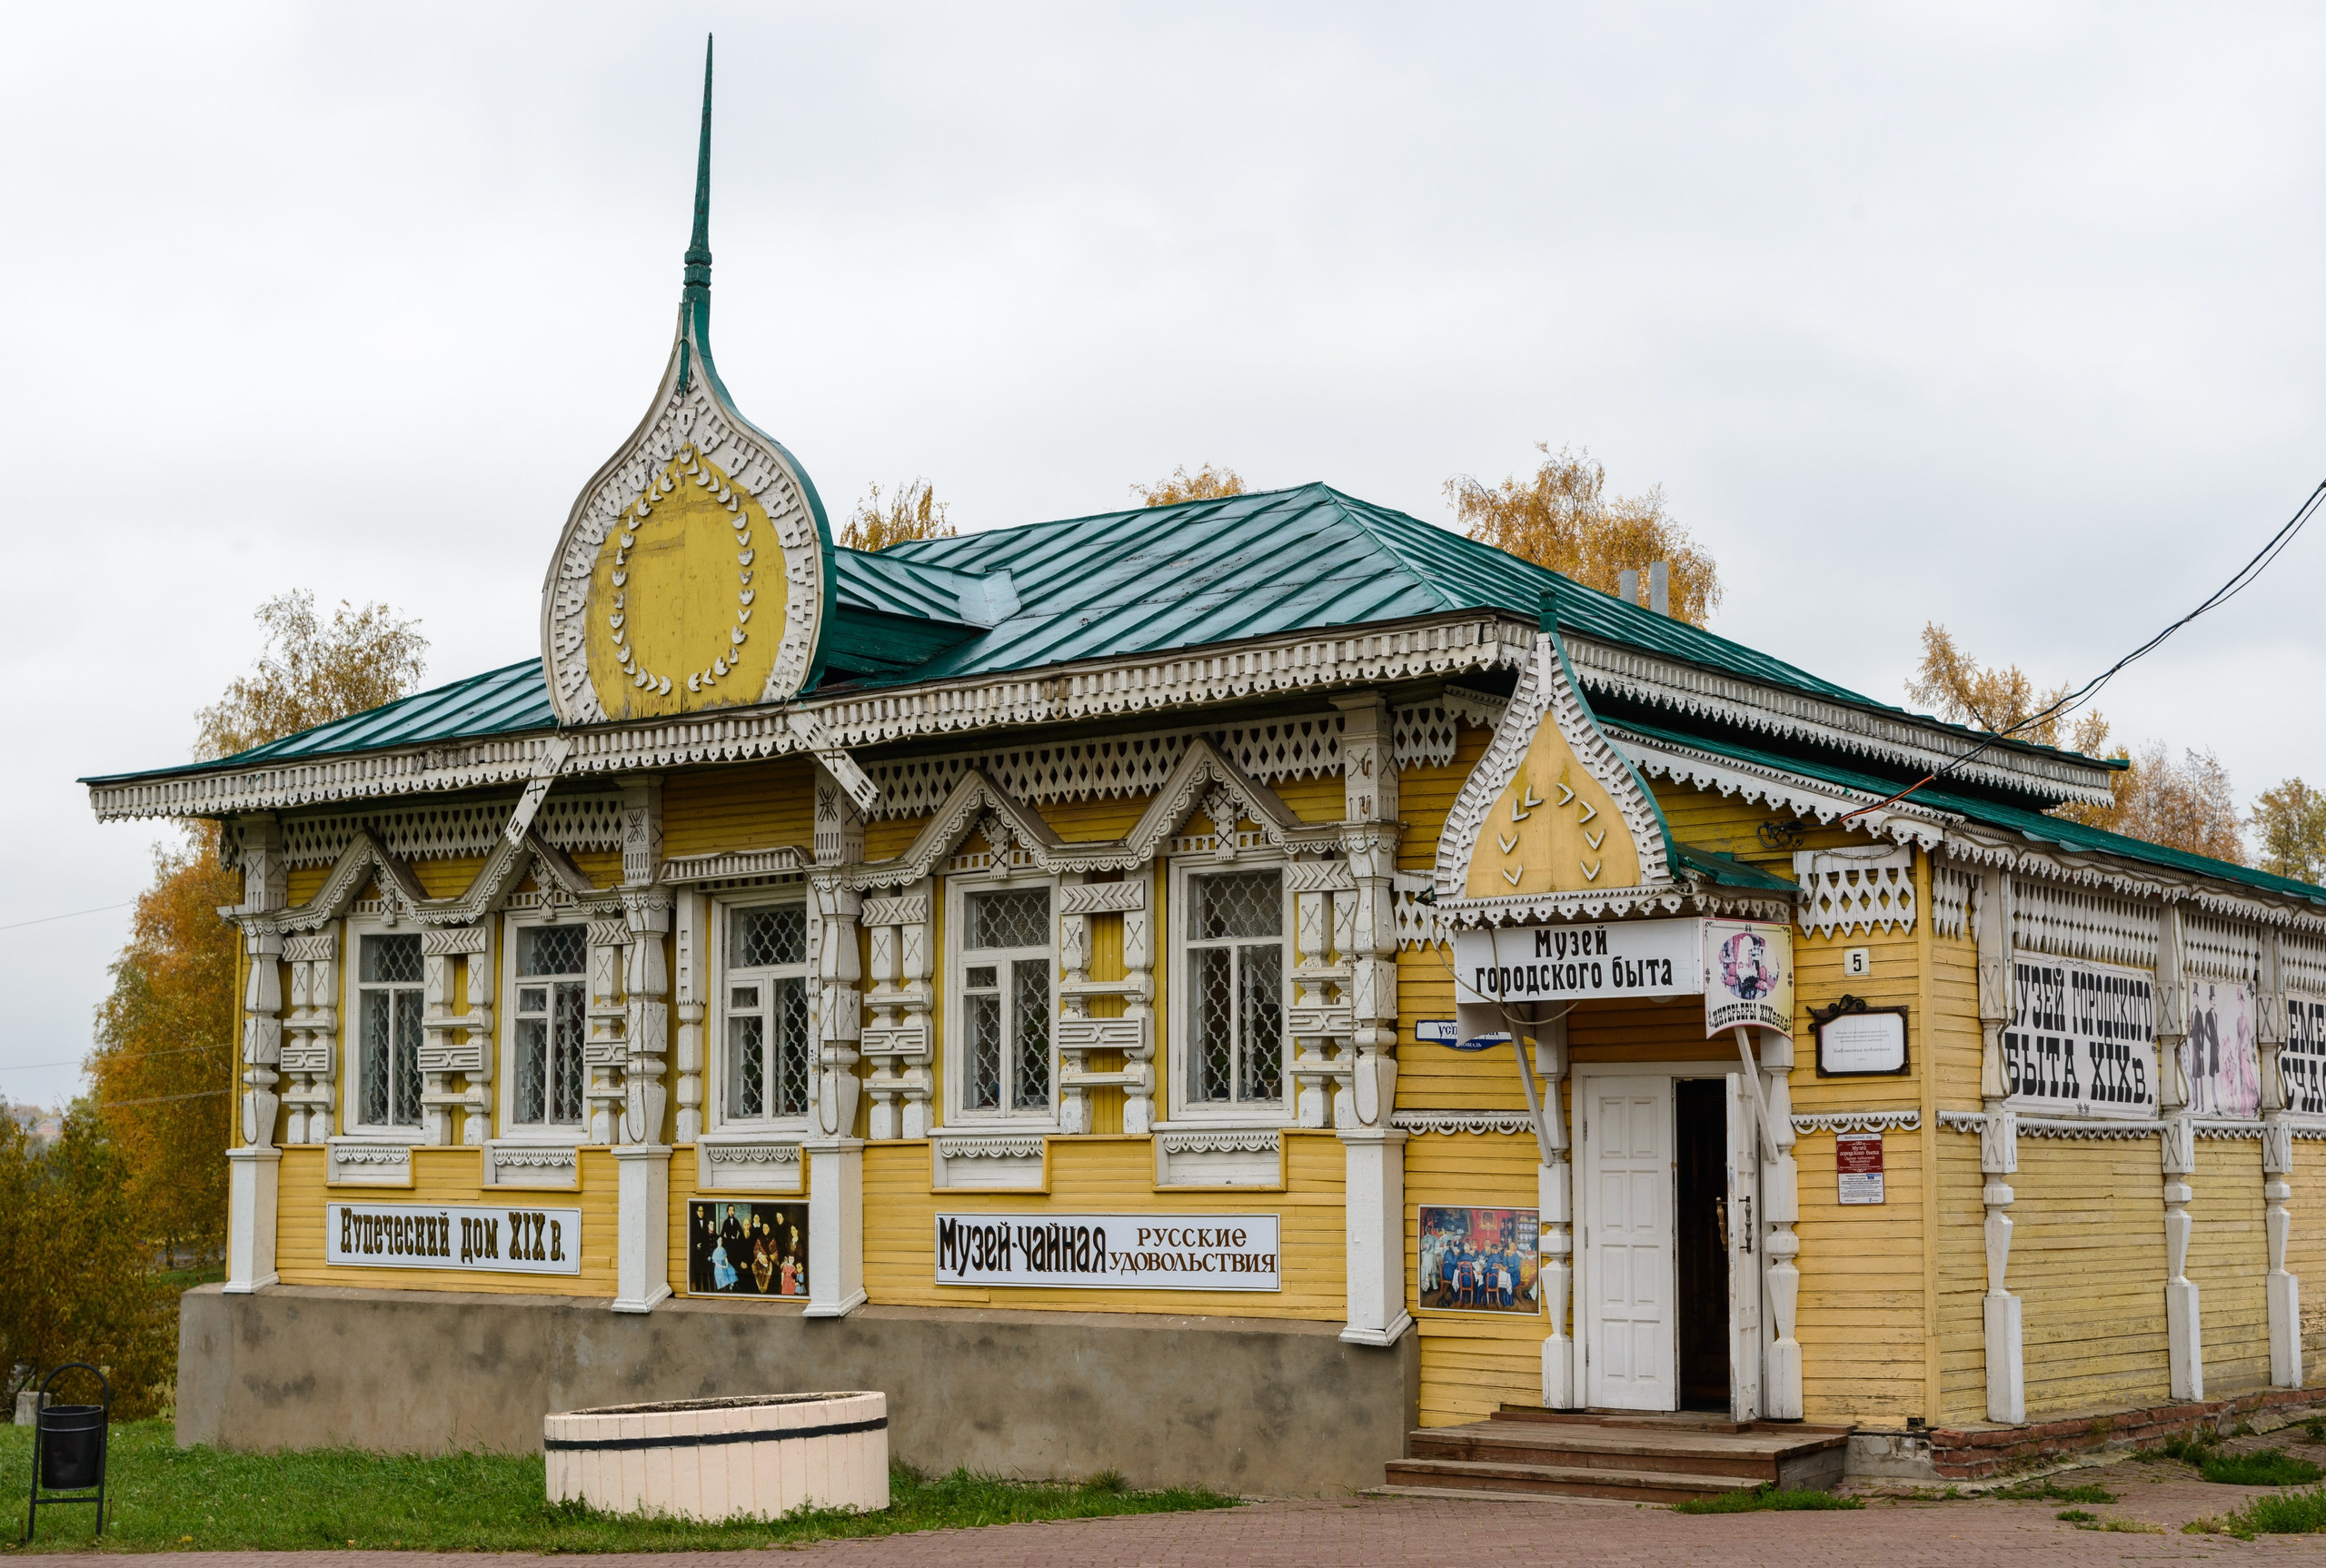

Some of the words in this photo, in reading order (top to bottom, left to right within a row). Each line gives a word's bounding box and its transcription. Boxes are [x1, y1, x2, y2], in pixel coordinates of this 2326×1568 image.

[1535, 925, 1609, 961] Музей
[1853, 954, 1862, 972] 5
[1476, 961, 1604, 997] городского
[1612, 956, 1674, 988] быта
[1713, 1002, 1756, 1028] ИНТЕРЬЕРЫ
[2072, 970, 2153, 1044] ГОРОДСКОГО
[2004, 1032, 2080, 1099] БЫТА
[2281, 1057, 2326, 1114] СЧА
[340, 1207, 451, 1257] Купеческий
[461, 1216, 499, 1264] дом
[508, 1212, 546, 1261] XIX
[550, 1219, 566, 1262] в.
